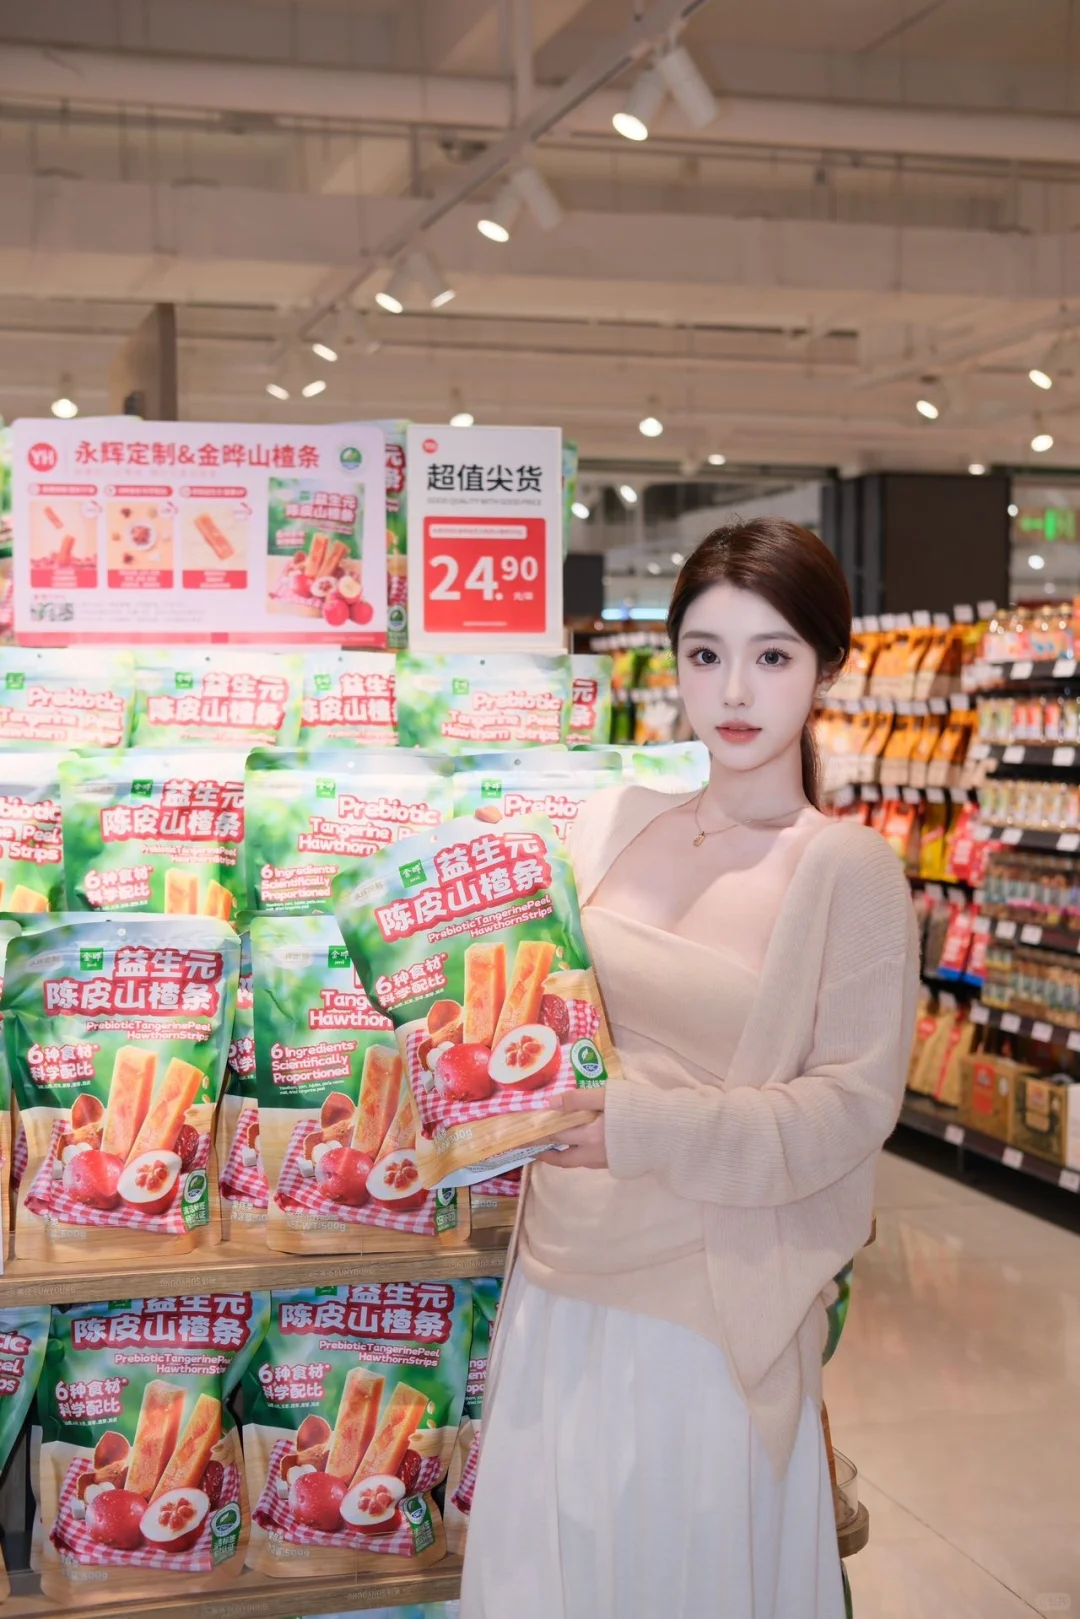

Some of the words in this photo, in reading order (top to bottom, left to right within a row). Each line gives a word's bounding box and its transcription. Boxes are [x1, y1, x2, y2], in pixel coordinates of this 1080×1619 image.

[31, 449, 56, 465] YH
[75, 441, 319, 468] 永辉定制&金晔山楂条
[427, 463, 542, 492] 超值尖货
[203, 674, 286, 701] 益生元
[341, 674, 395, 698] 益生
[149, 698, 281, 728] 陈皮山楂条
[302, 698, 397, 725] 陈皮山楂
[473, 692, 562, 711] Prebiotic
[165, 781, 244, 808] 益生元
[340, 796, 441, 825] Prebiotic
[506, 797, 579, 819] Prebio
[23, 825, 60, 843] Peel
[103, 808, 241, 838] 陈皮山楂条
[311, 818, 391, 842] Tangerine
[10, 844, 59, 863] Strips
[437, 834, 542, 882] 益生元
[261, 864, 273, 879] 6
[378, 859, 545, 936] 陈皮山楂条
[428, 895, 552, 943] PrebioticTangerinePeel
[469, 907, 553, 938] HawthornStrips
[116, 949, 217, 979] 益生元
[46, 981, 212, 1011] 陈皮山楂条
[321, 991, 371, 1010] Tang
[379, 974, 446, 1006] 科学配比
[86, 1020, 212, 1033] PrebioticTangerinePeel
[127, 1031, 210, 1042] HawthornStrips
[270, 1043, 283, 1059] 6
[285, 1041, 354, 1058] Ingredients
[30, 1061, 94, 1081] 科学配比
[272, 1054, 348, 1071] Scientifically
[273, 1065, 349, 1084] Proportioned
[146, 1292, 246, 1314] 益生元
[350, 1283, 448, 1308] 益生元
[75, 1315, 244, 1345] 陈皮山楂条
[281, 1302, 445, 1337] 陈皮山楂条
[320, 1341, 440, 1358] PrebioticTangerinePeel
[358, 1352, 438, 1367] HawthornStrips
[262, 1382, 323, 1401] 科学配比
[58, 1398, 121, 1418] 科学配比
